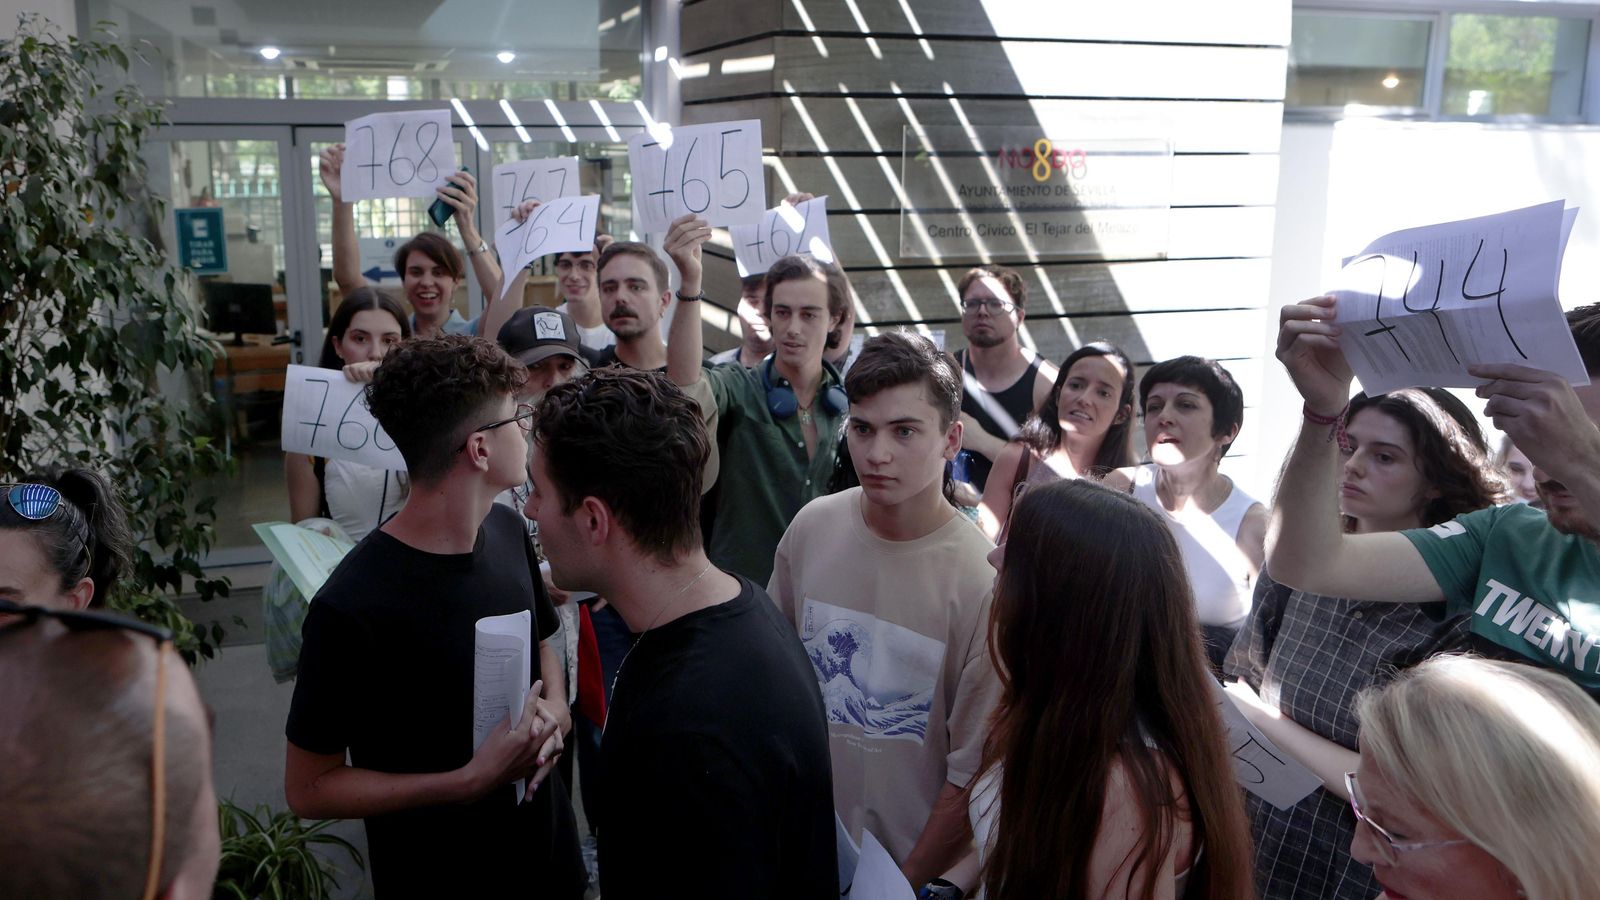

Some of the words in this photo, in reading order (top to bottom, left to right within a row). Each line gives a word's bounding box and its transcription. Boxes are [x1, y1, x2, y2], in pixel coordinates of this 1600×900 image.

[355, 121, 440, 191] 768
[642, 128, 750, 219] 765
[1054, 184, 1069, 197] DE
[928, 222, 972, 238] Centro
[1041, 221, 1072, 238] Tejar
[1349, 238, 1529, 366] 744
